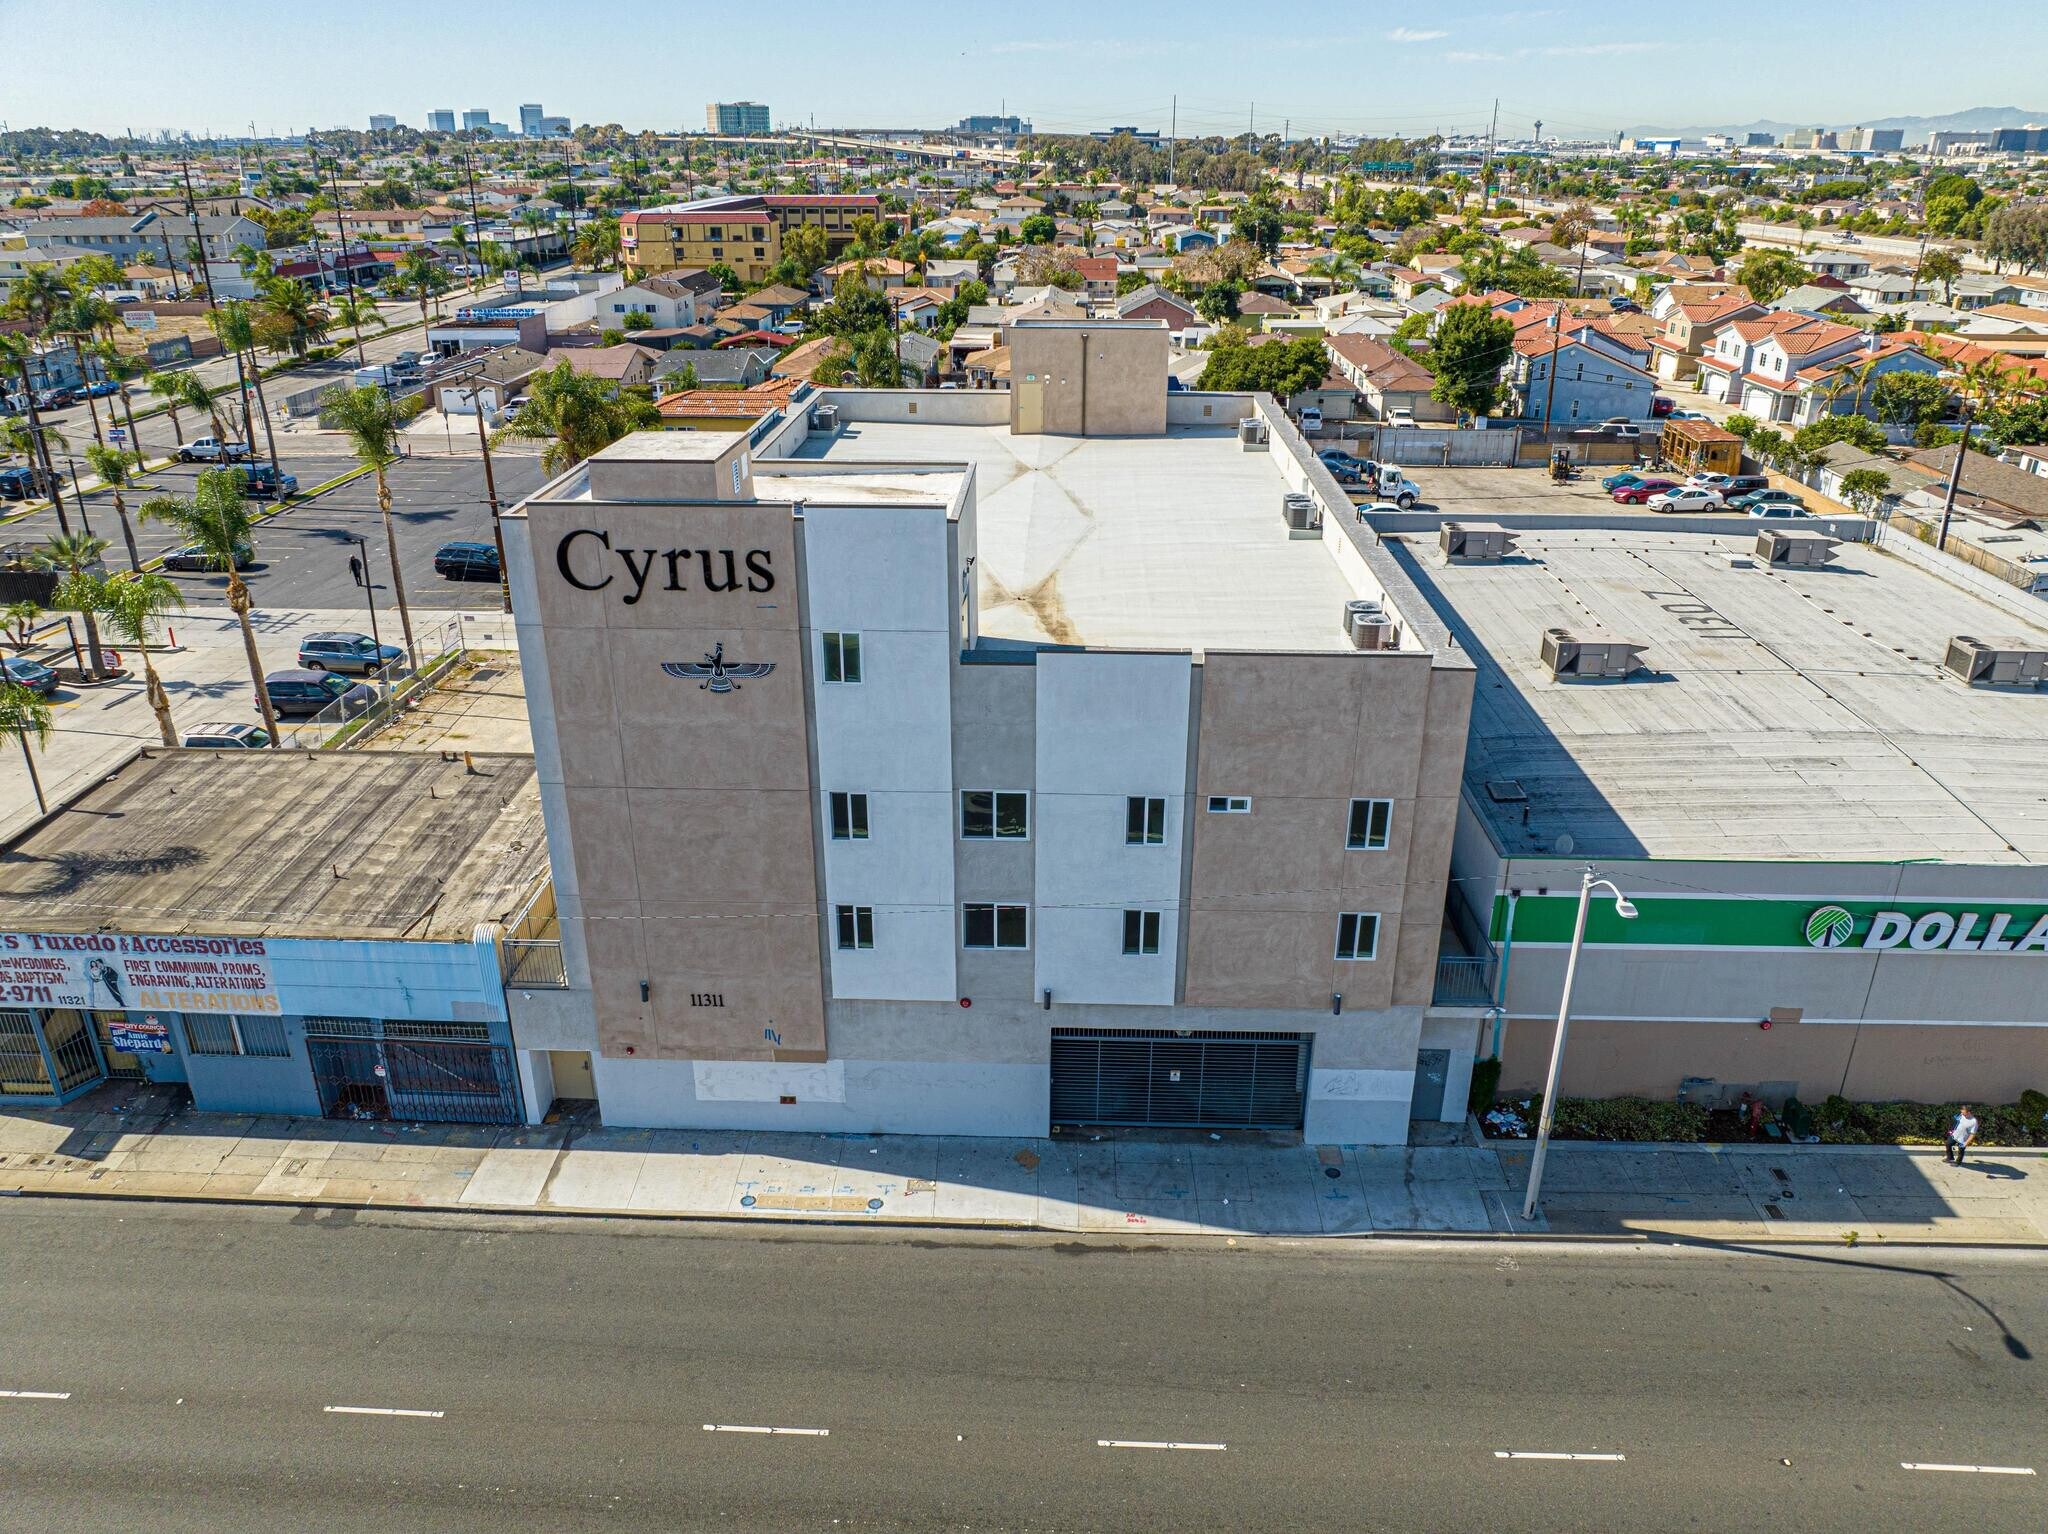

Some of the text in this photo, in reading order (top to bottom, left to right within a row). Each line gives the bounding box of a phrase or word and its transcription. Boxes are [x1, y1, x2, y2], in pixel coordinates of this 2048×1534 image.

[556, 529, 776, 605] Cyrus
[1861, 911, 2048, 951] DOLLA
[27, 934, 117, 951] Tuxedo
[120, 937, 130, 951] &
[132, 937, 266, 955] Accessories
[124, 960, 151, 973] FIRST
[195, 976, 266, 990] ALTERATIONS
[58, 996, 86, 1005] 11321
[140, 991, 280, 1011] ALTERATIONS
[690, 993, 726, 1008] 11311
[112, 1036, 162, 1049] Shepard
